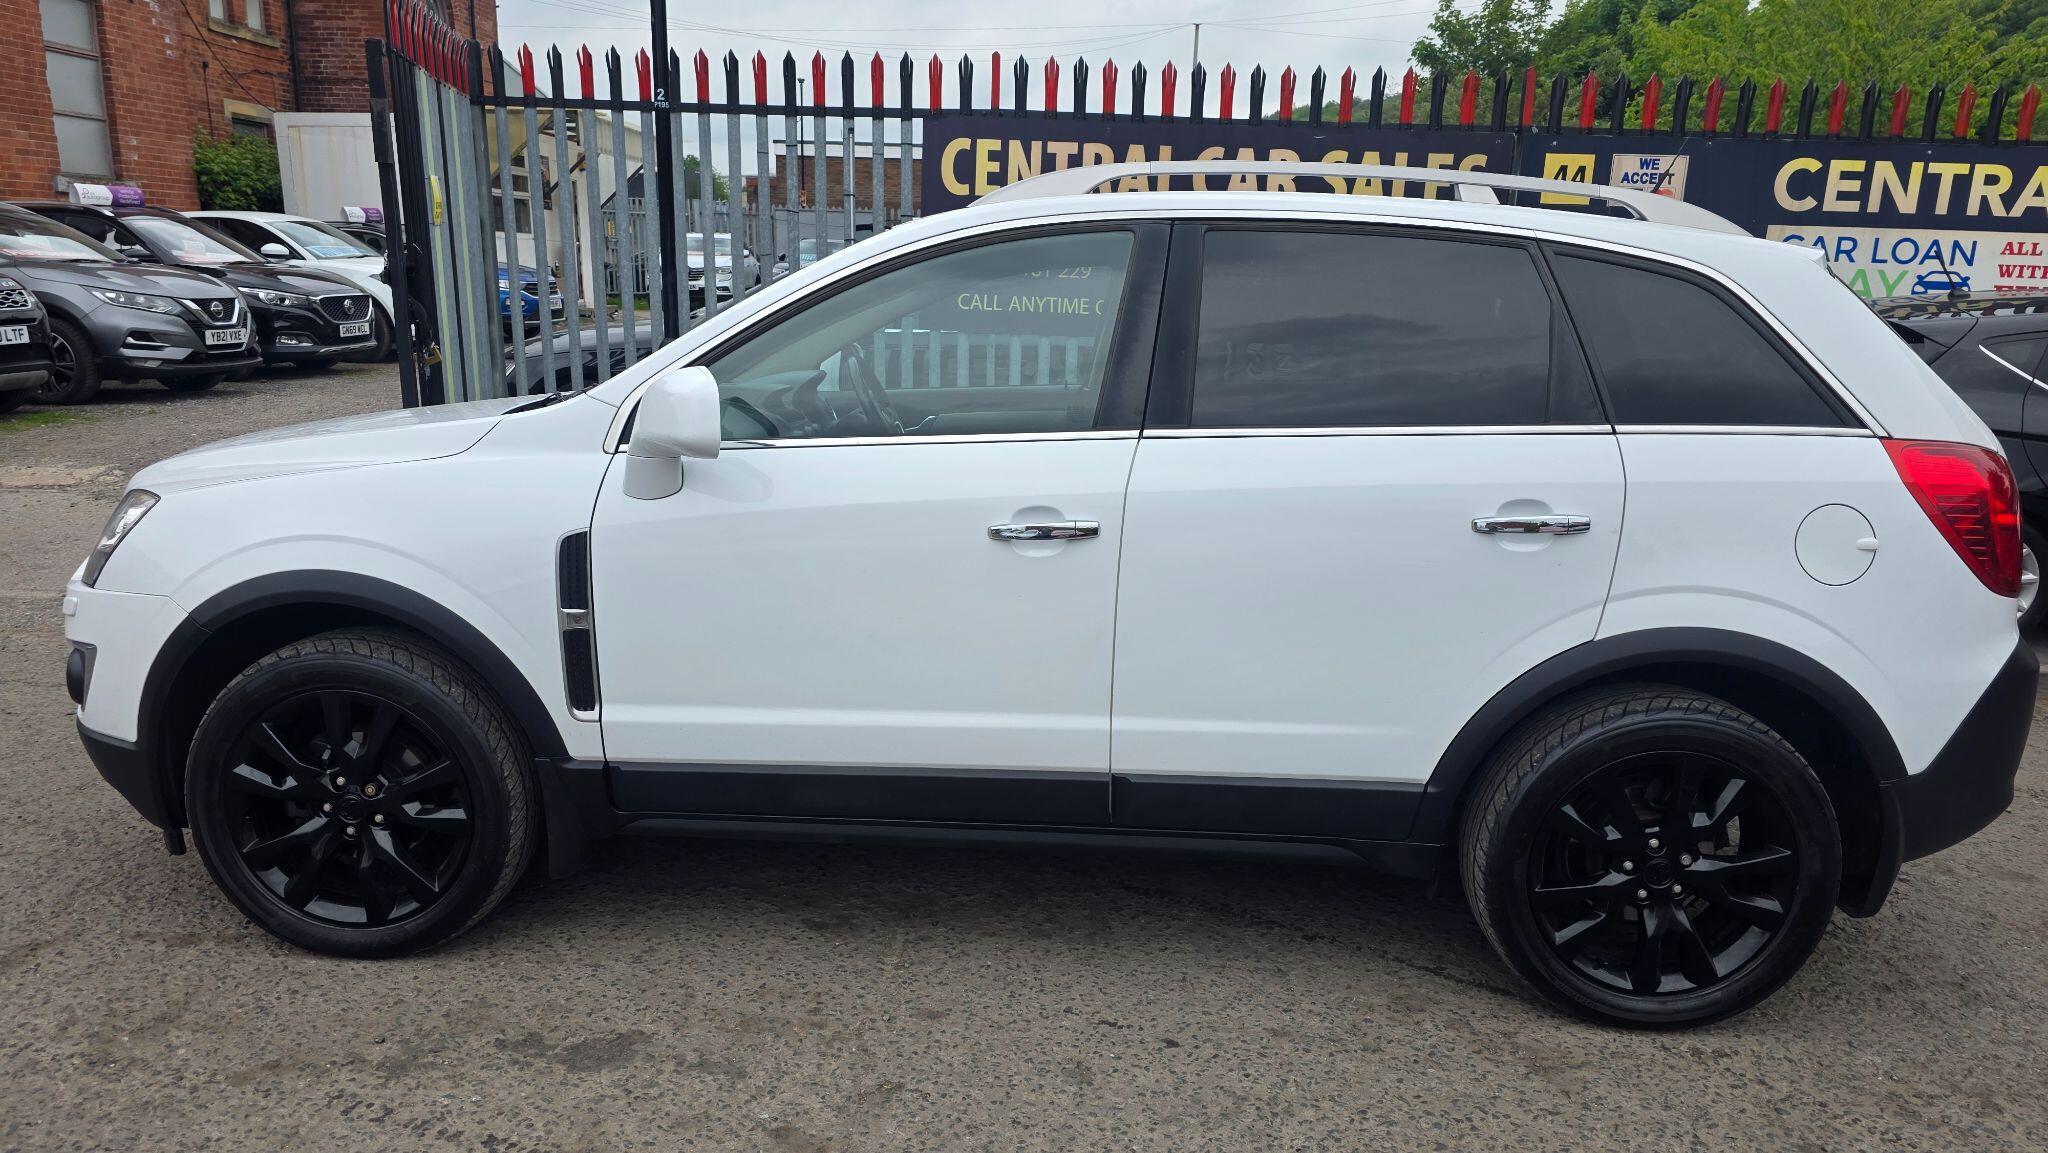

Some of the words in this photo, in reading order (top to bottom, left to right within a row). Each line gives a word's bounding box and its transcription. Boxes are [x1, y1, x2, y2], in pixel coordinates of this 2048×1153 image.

[657, 88, 665, 101] 2
[1639, 157, 1661, 170] WE
[1620, 171, 1675, 185] ACCET
[1782, 235, 1859, 263] AR
[1871, 237, 1978, 267] LOAN
[2000, 241, 2043, 256] ALL
[1848, 268, 1910, 298] AY
[958, 293, 1003, 311] CALL
[1008, 295, 1090, 315] ANYTIME
[4, 328, 24, 342] LTF
[229, 330, 242, 341] VXE
